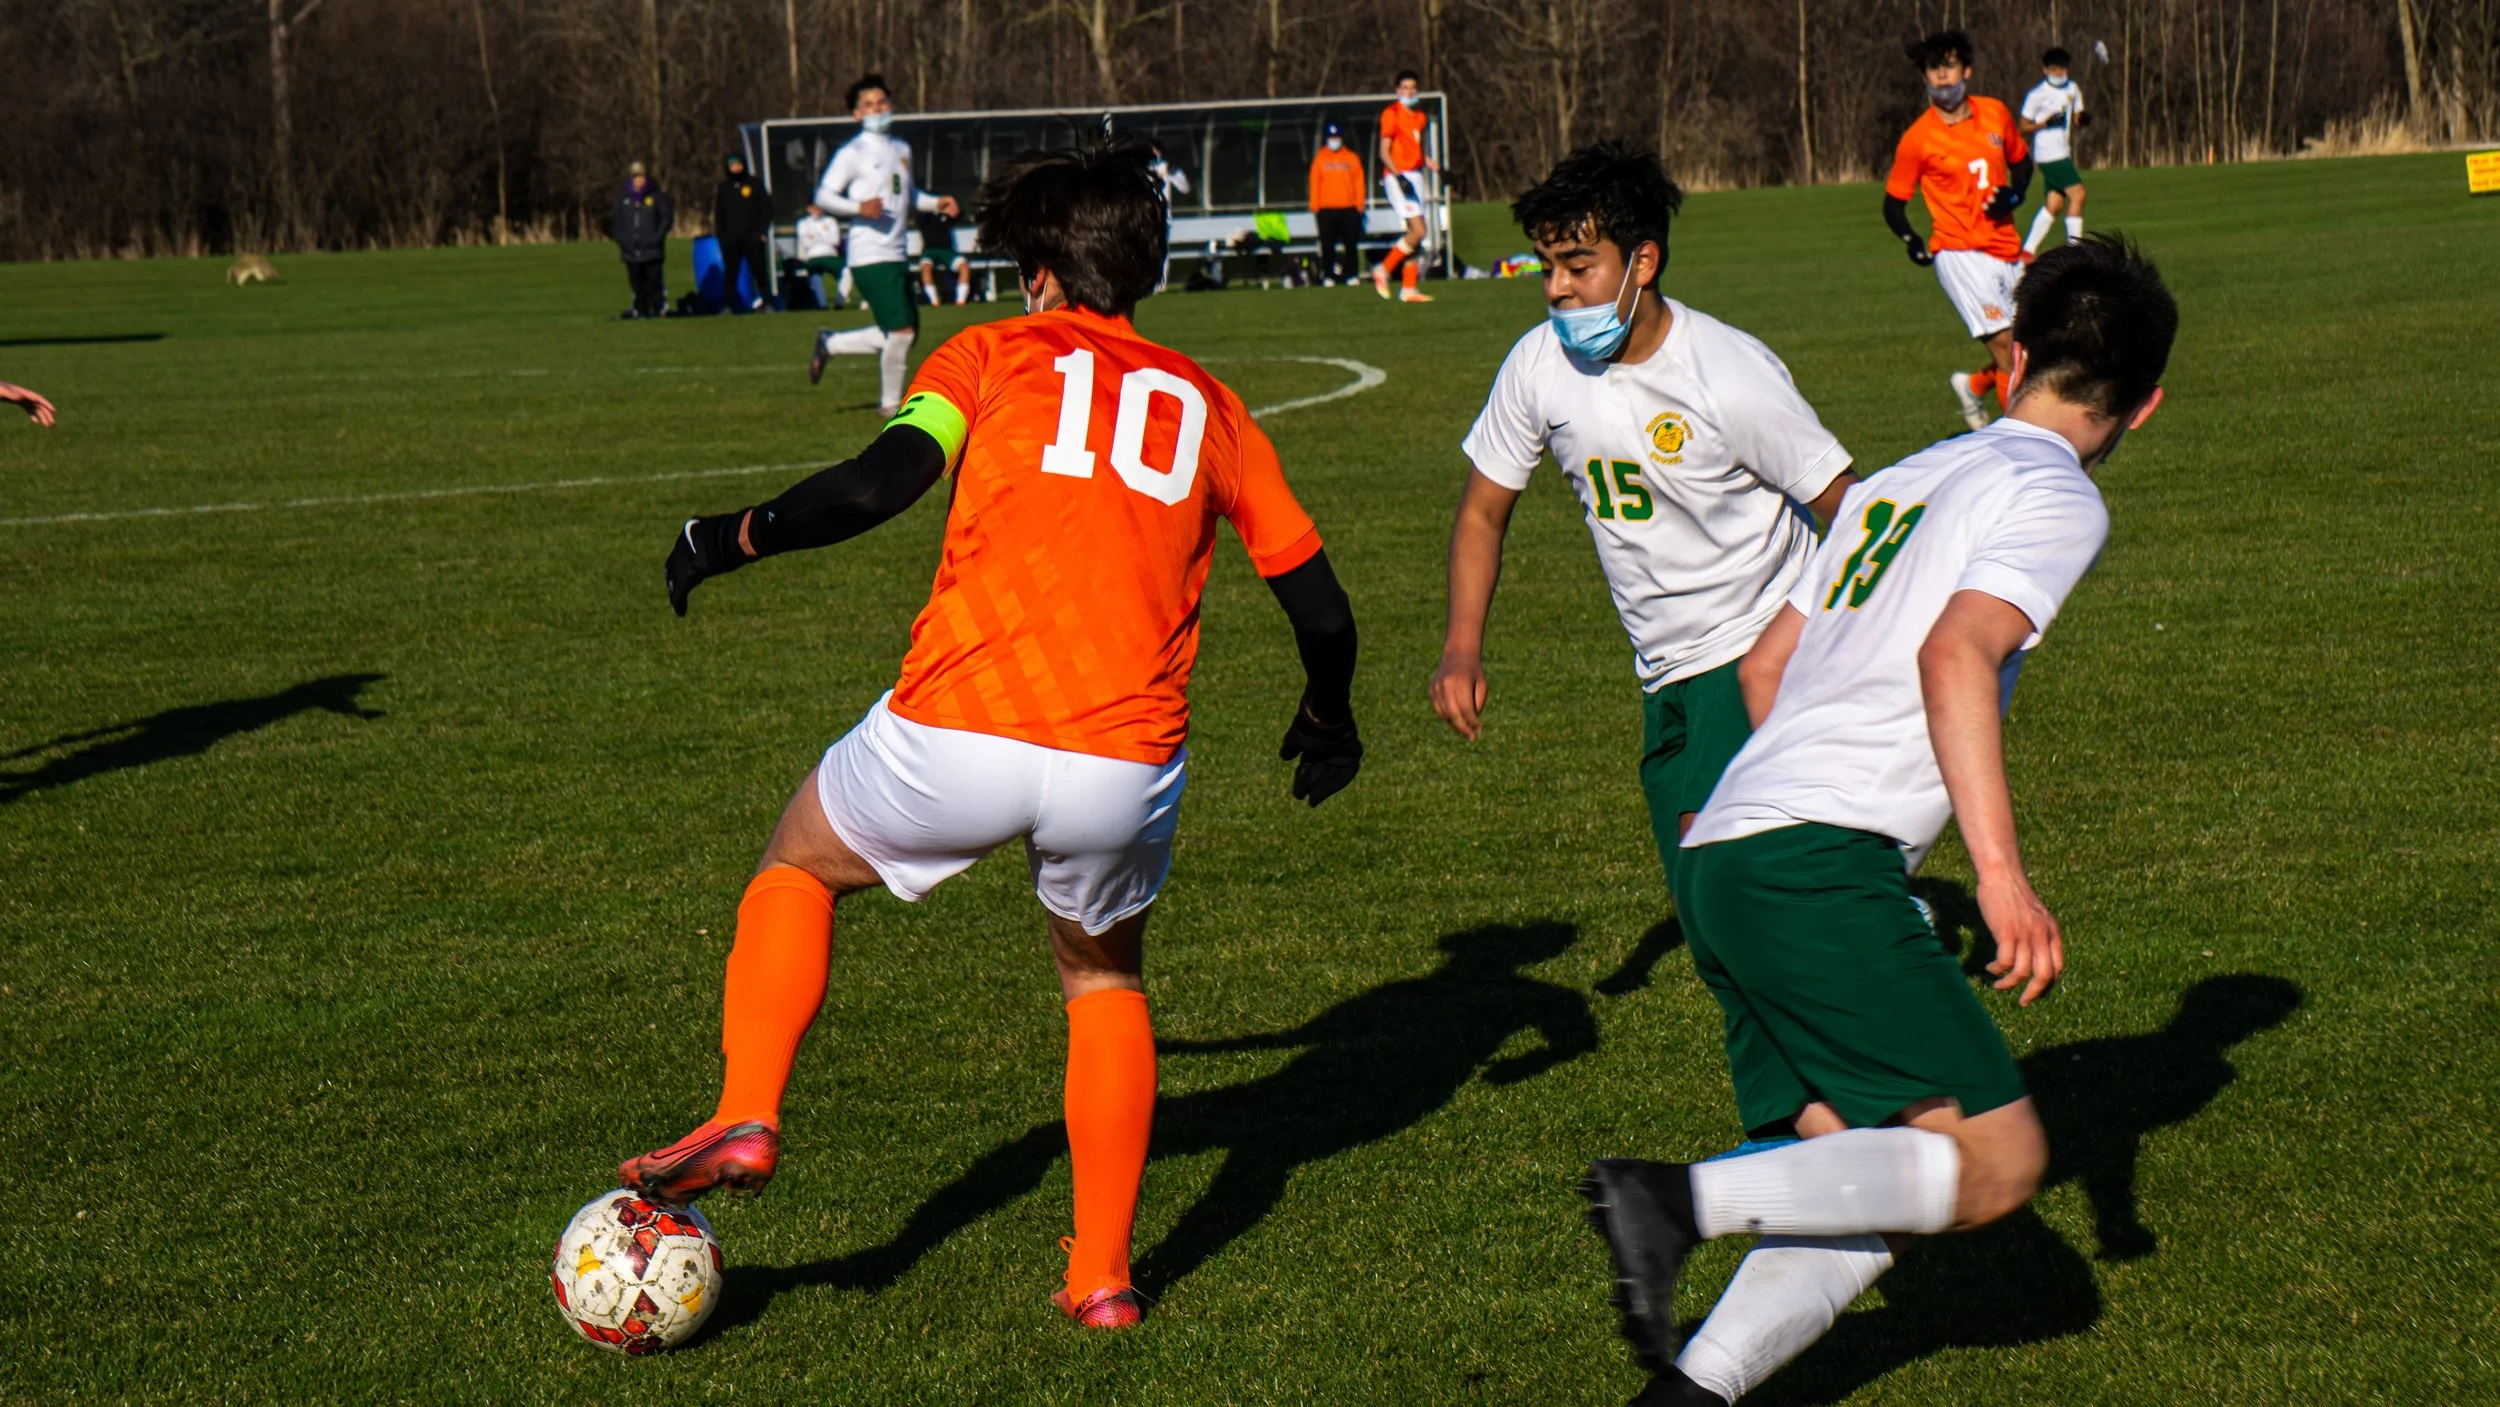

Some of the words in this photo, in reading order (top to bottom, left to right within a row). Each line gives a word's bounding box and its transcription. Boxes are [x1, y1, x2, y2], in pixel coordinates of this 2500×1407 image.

[1968, 157, 1989, 190] 7
[1041, 347, 1207, 506] 10
[1585, 456, 1654, 522] 15
[1824, 497, 1927, 611] 19
